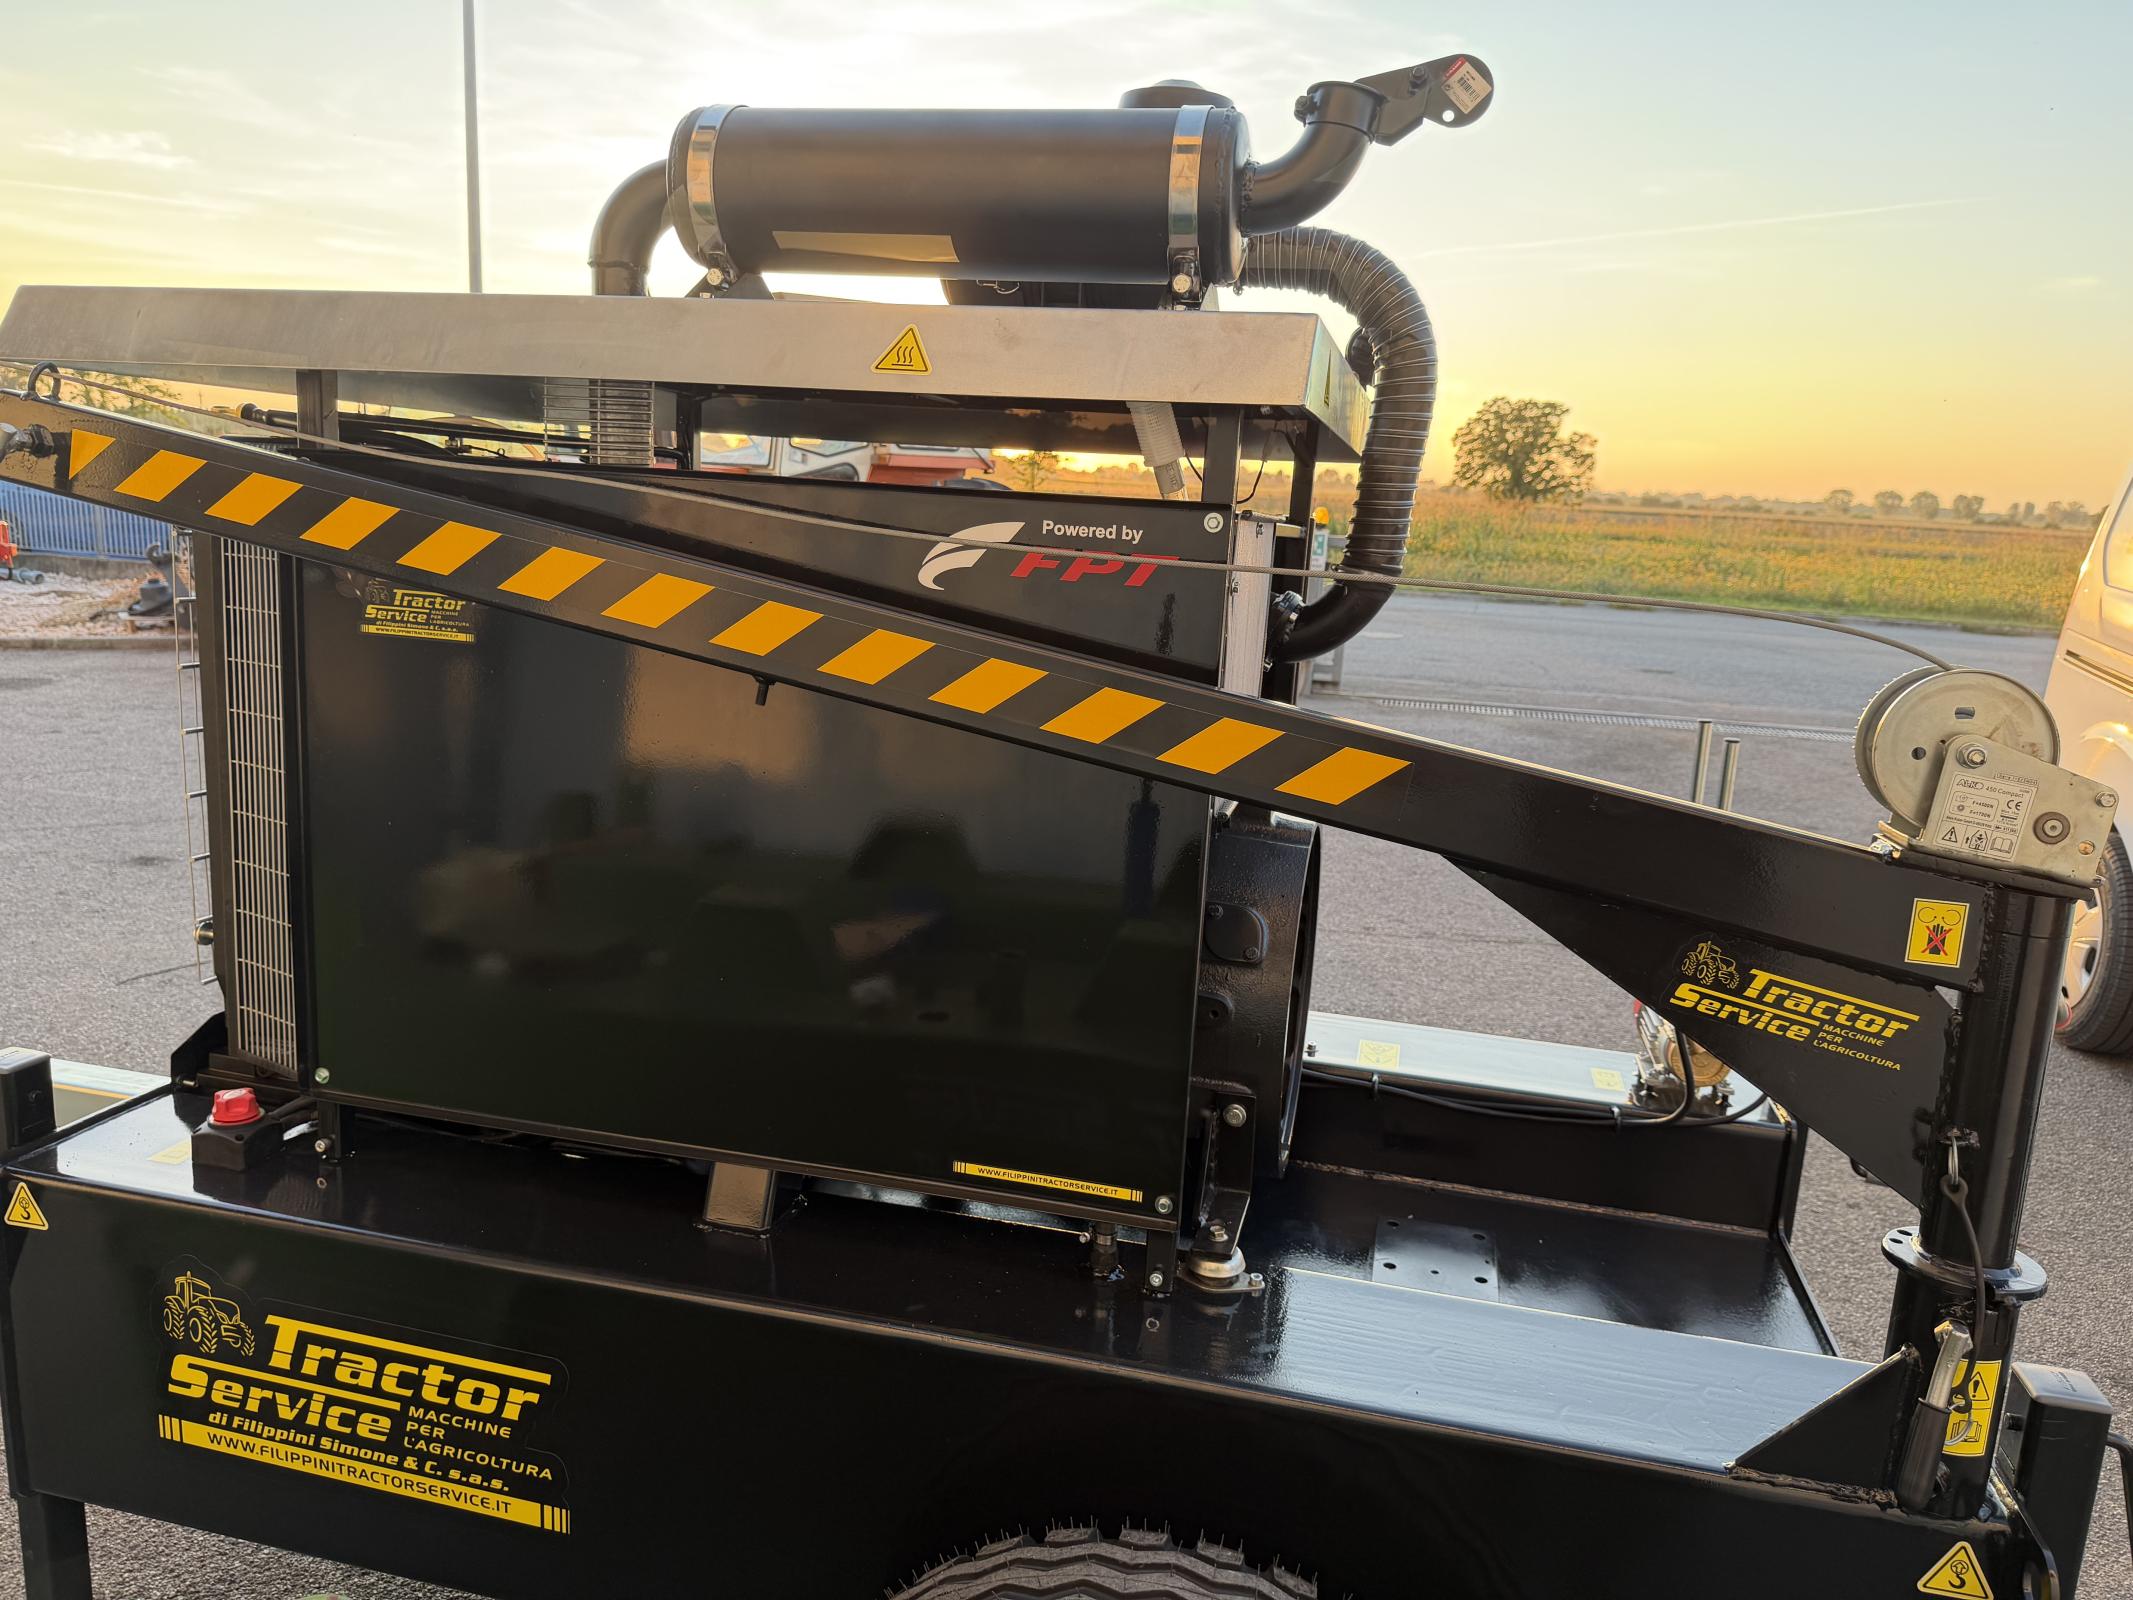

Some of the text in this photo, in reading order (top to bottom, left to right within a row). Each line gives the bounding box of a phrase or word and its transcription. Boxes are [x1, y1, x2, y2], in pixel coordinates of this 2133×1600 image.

[1042, 519, 1144, 545] Powered by
[1009, 546, 1181, 588] FPT
[365, 604, 430, 622] Service
[393, 589, 466, 610] Tractor
[1997, 788, 2024, 798] Compact
[1669, 982, 1820, 1042] Service
[1742, 968, 1920, 1039] Tractor
[1818, 1031, 1843, 1045] PER
[1822, 1024, 1887, 1048] MACCHINE
[977, 1166, 1119, 1196] WWW.FILIPPINITRACTORSERVICE.IT
[264, 1314, 552, 1421] Tractor
[167, 1353, 401, 1442] Service
[405, 1421, 445, 1442] PER
[408, 1405, 512, 1440] MACCHINE
[207, 1411, 510, 1491] di Filippini Simone & C. s.a.s.
[403, 1436, 553, 1481] L'AGRICOLTURA
[207, 1431, 512, 1515] WWW.FILIPPINITRACTORSERVICE.IT
